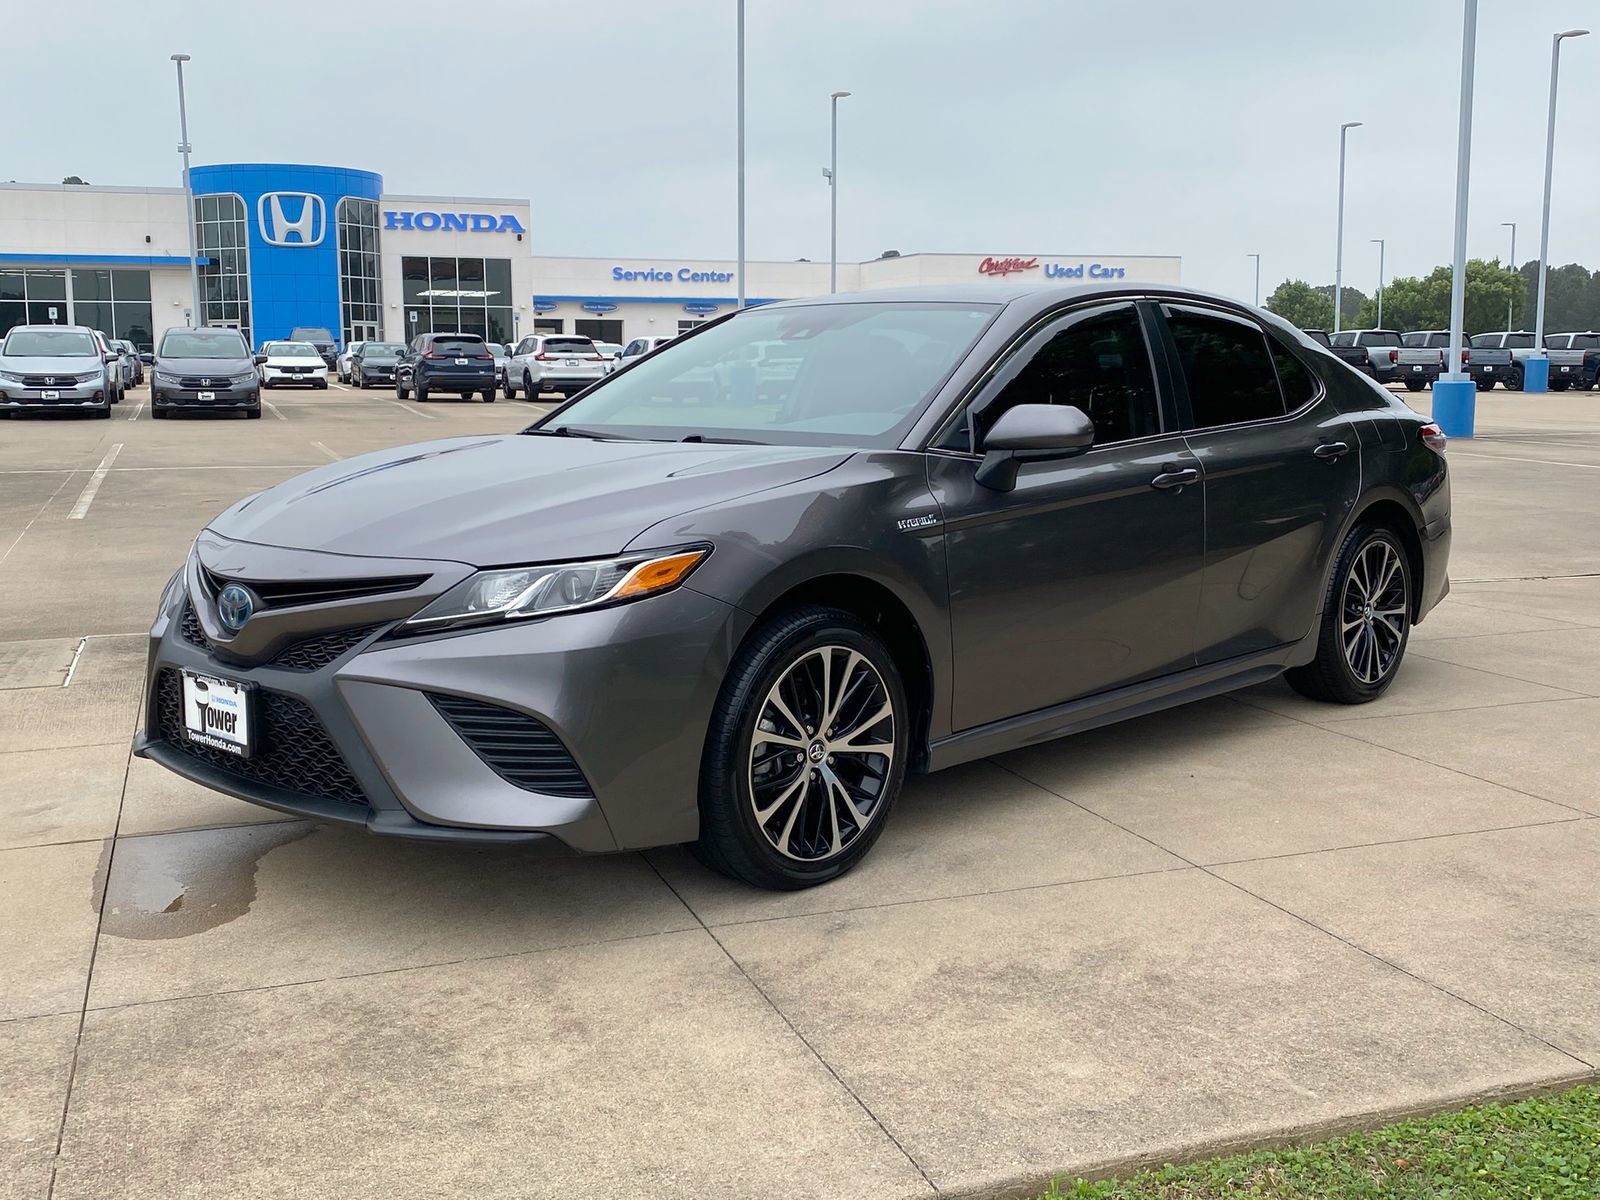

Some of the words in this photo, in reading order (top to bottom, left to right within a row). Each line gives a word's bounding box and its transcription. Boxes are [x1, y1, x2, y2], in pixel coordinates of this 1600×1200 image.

[383, 211, 526, 234] HONDA
[612, 266, 673, 281] Service
[677, 268, 734, 283] Center
[978, 257, 1040, 277] Certified
[1045, 263, 1084, 278] Used
[1089, 263, 1125, 279] Cars
[195, 699, 237, 734] Tower
[187, 729, 242, 755] TowerHonda.com
